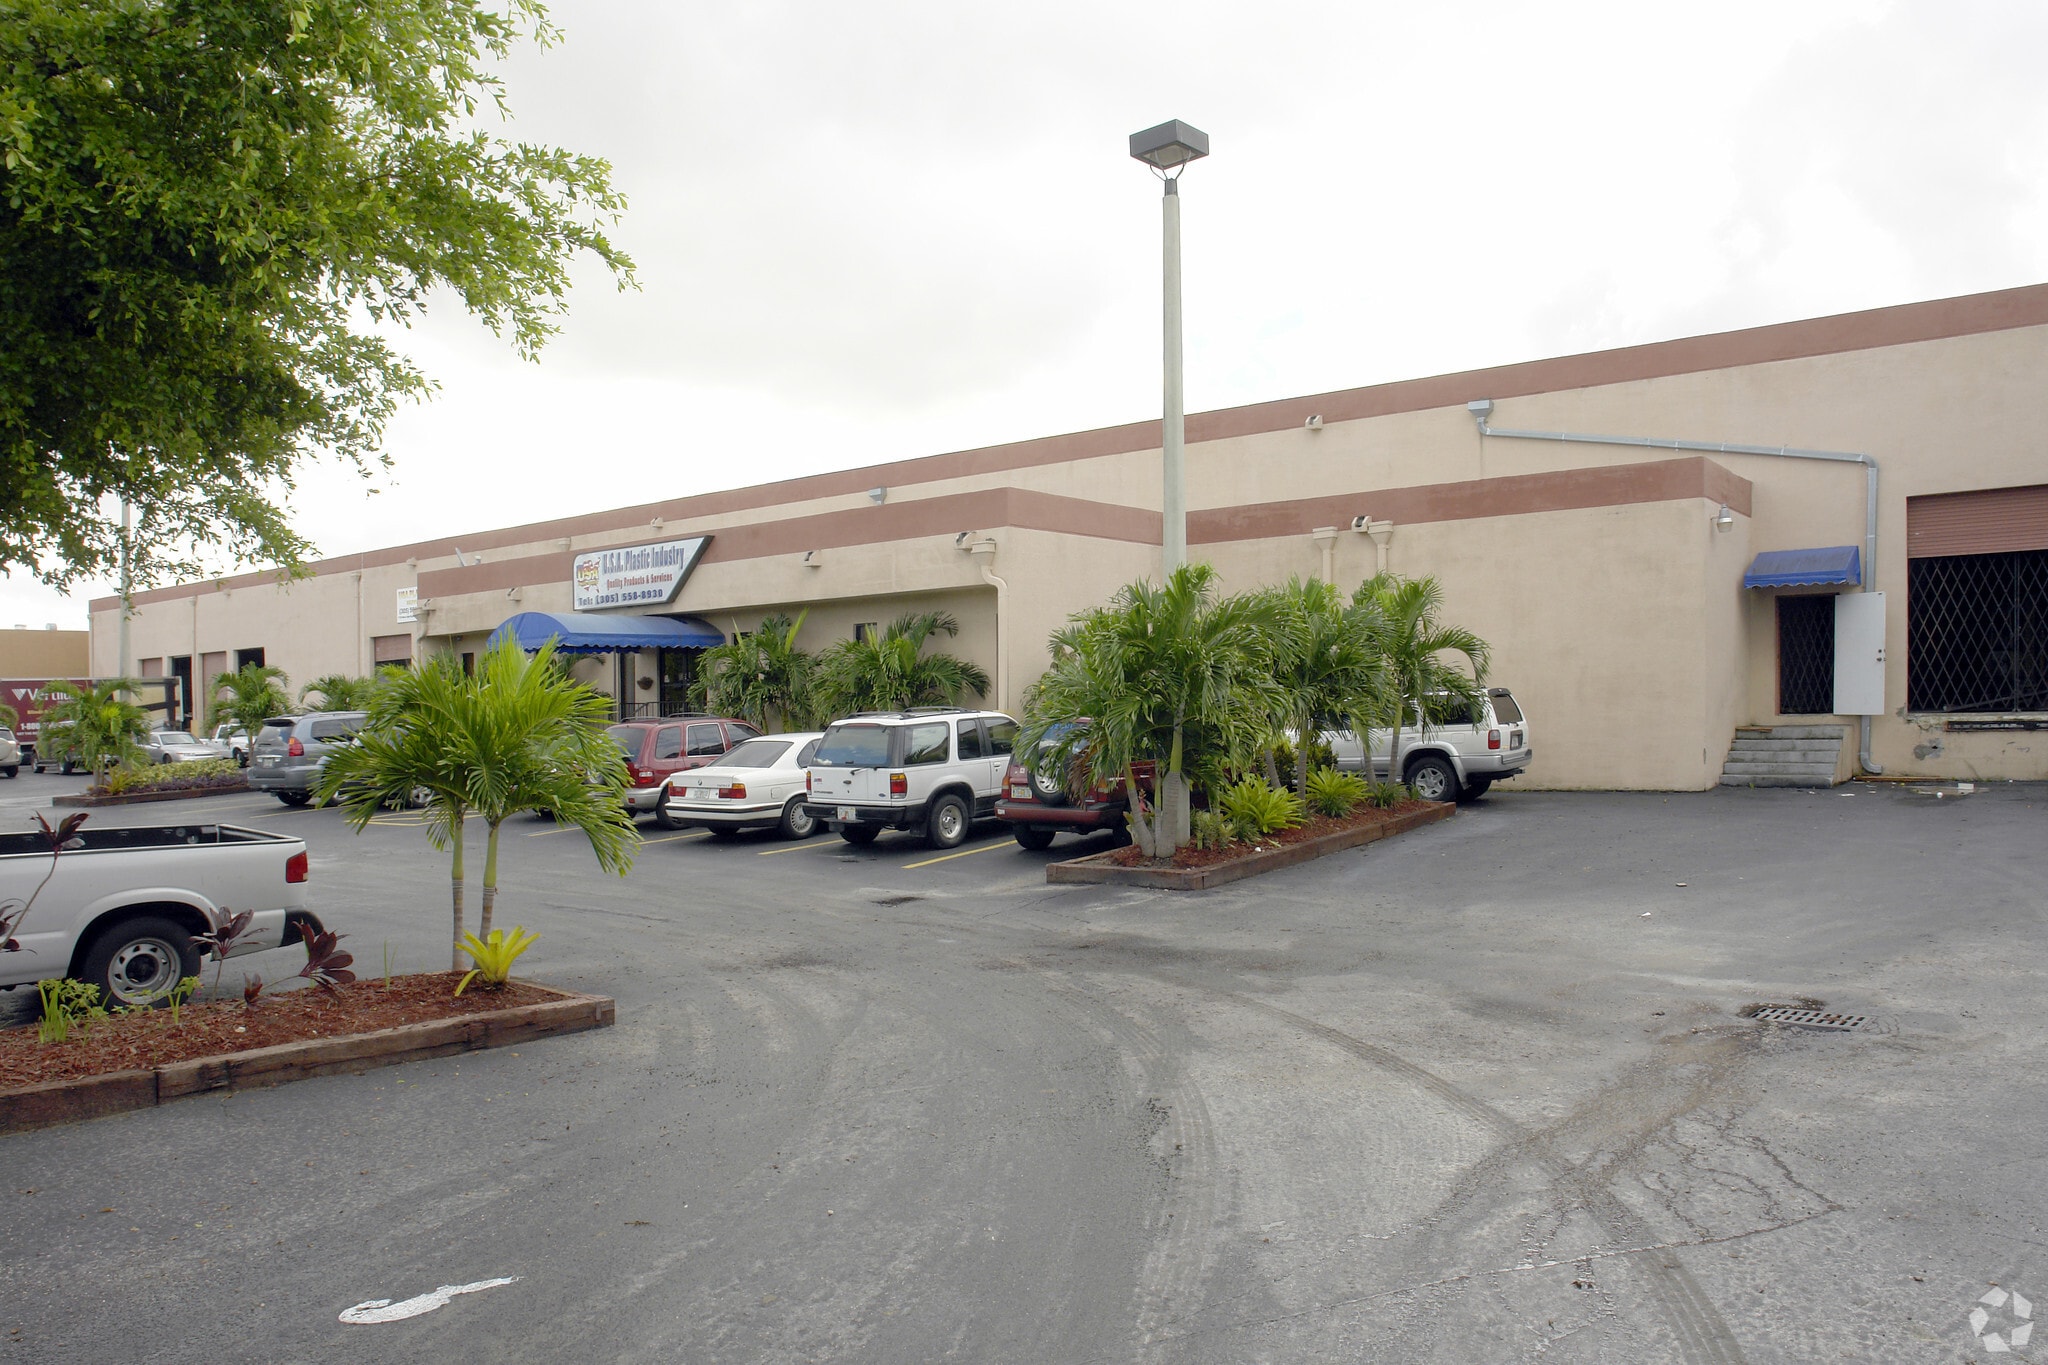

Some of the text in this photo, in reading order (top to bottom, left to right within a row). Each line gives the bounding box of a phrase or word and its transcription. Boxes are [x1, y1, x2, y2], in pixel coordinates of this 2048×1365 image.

[603, 545, 684, 575] U.S.A. Plastic Industry
[577, 565, 599, 580] USA
[607, 577, 622, 591] Quality
[623, 575, 645, 587] Products
[650, 573, 673, 584] Services
[578, 597, 593, 606] Tel:
[622, 589, 663, 601] 558-8930
